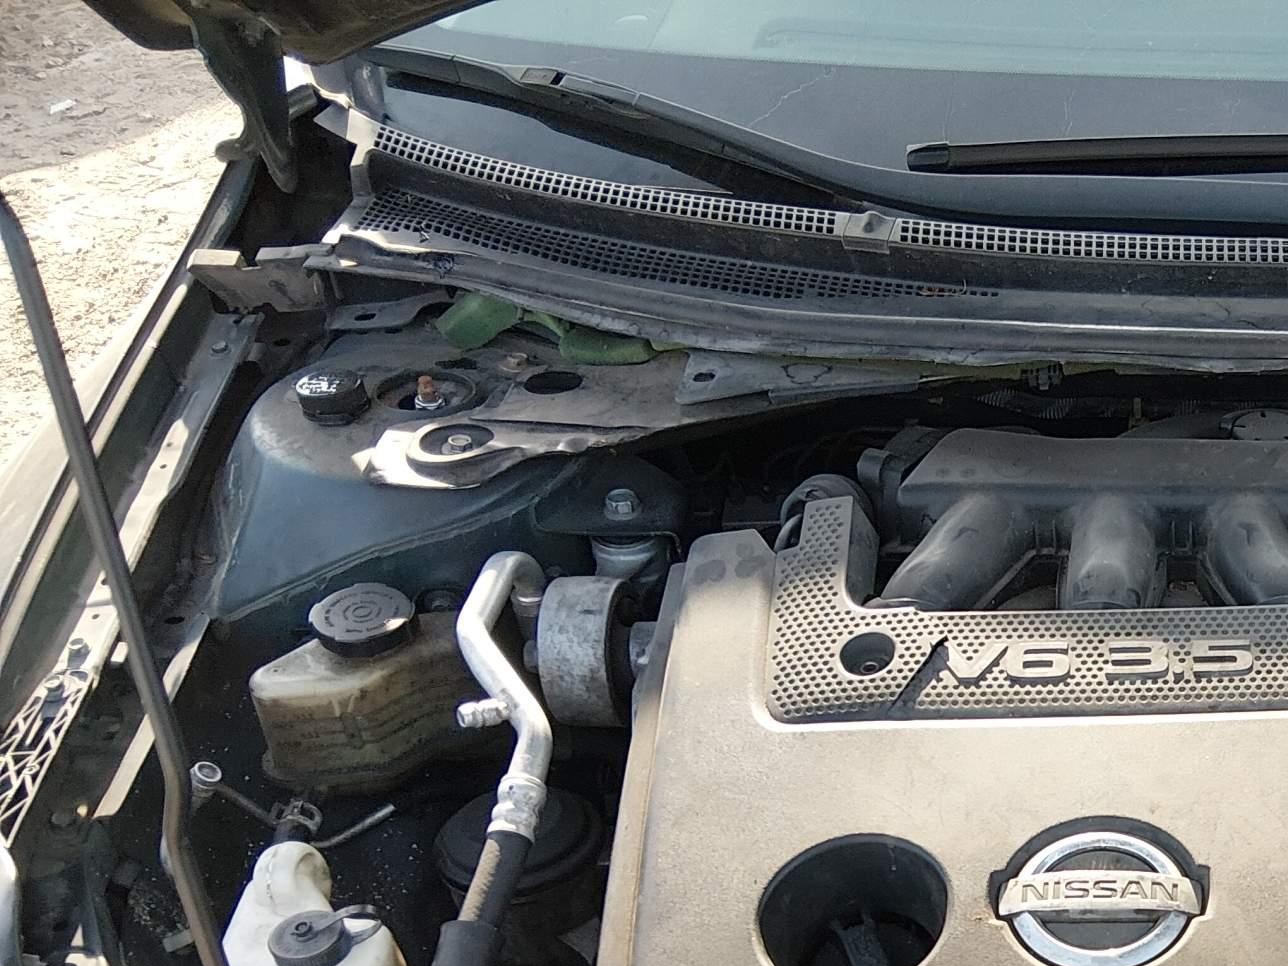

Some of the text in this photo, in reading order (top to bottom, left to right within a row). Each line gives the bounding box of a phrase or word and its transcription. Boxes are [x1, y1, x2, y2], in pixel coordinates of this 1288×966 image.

[945, 639, 1253, 682] V6 3.5
[1021, 879, 1179, 903] NISSAN
